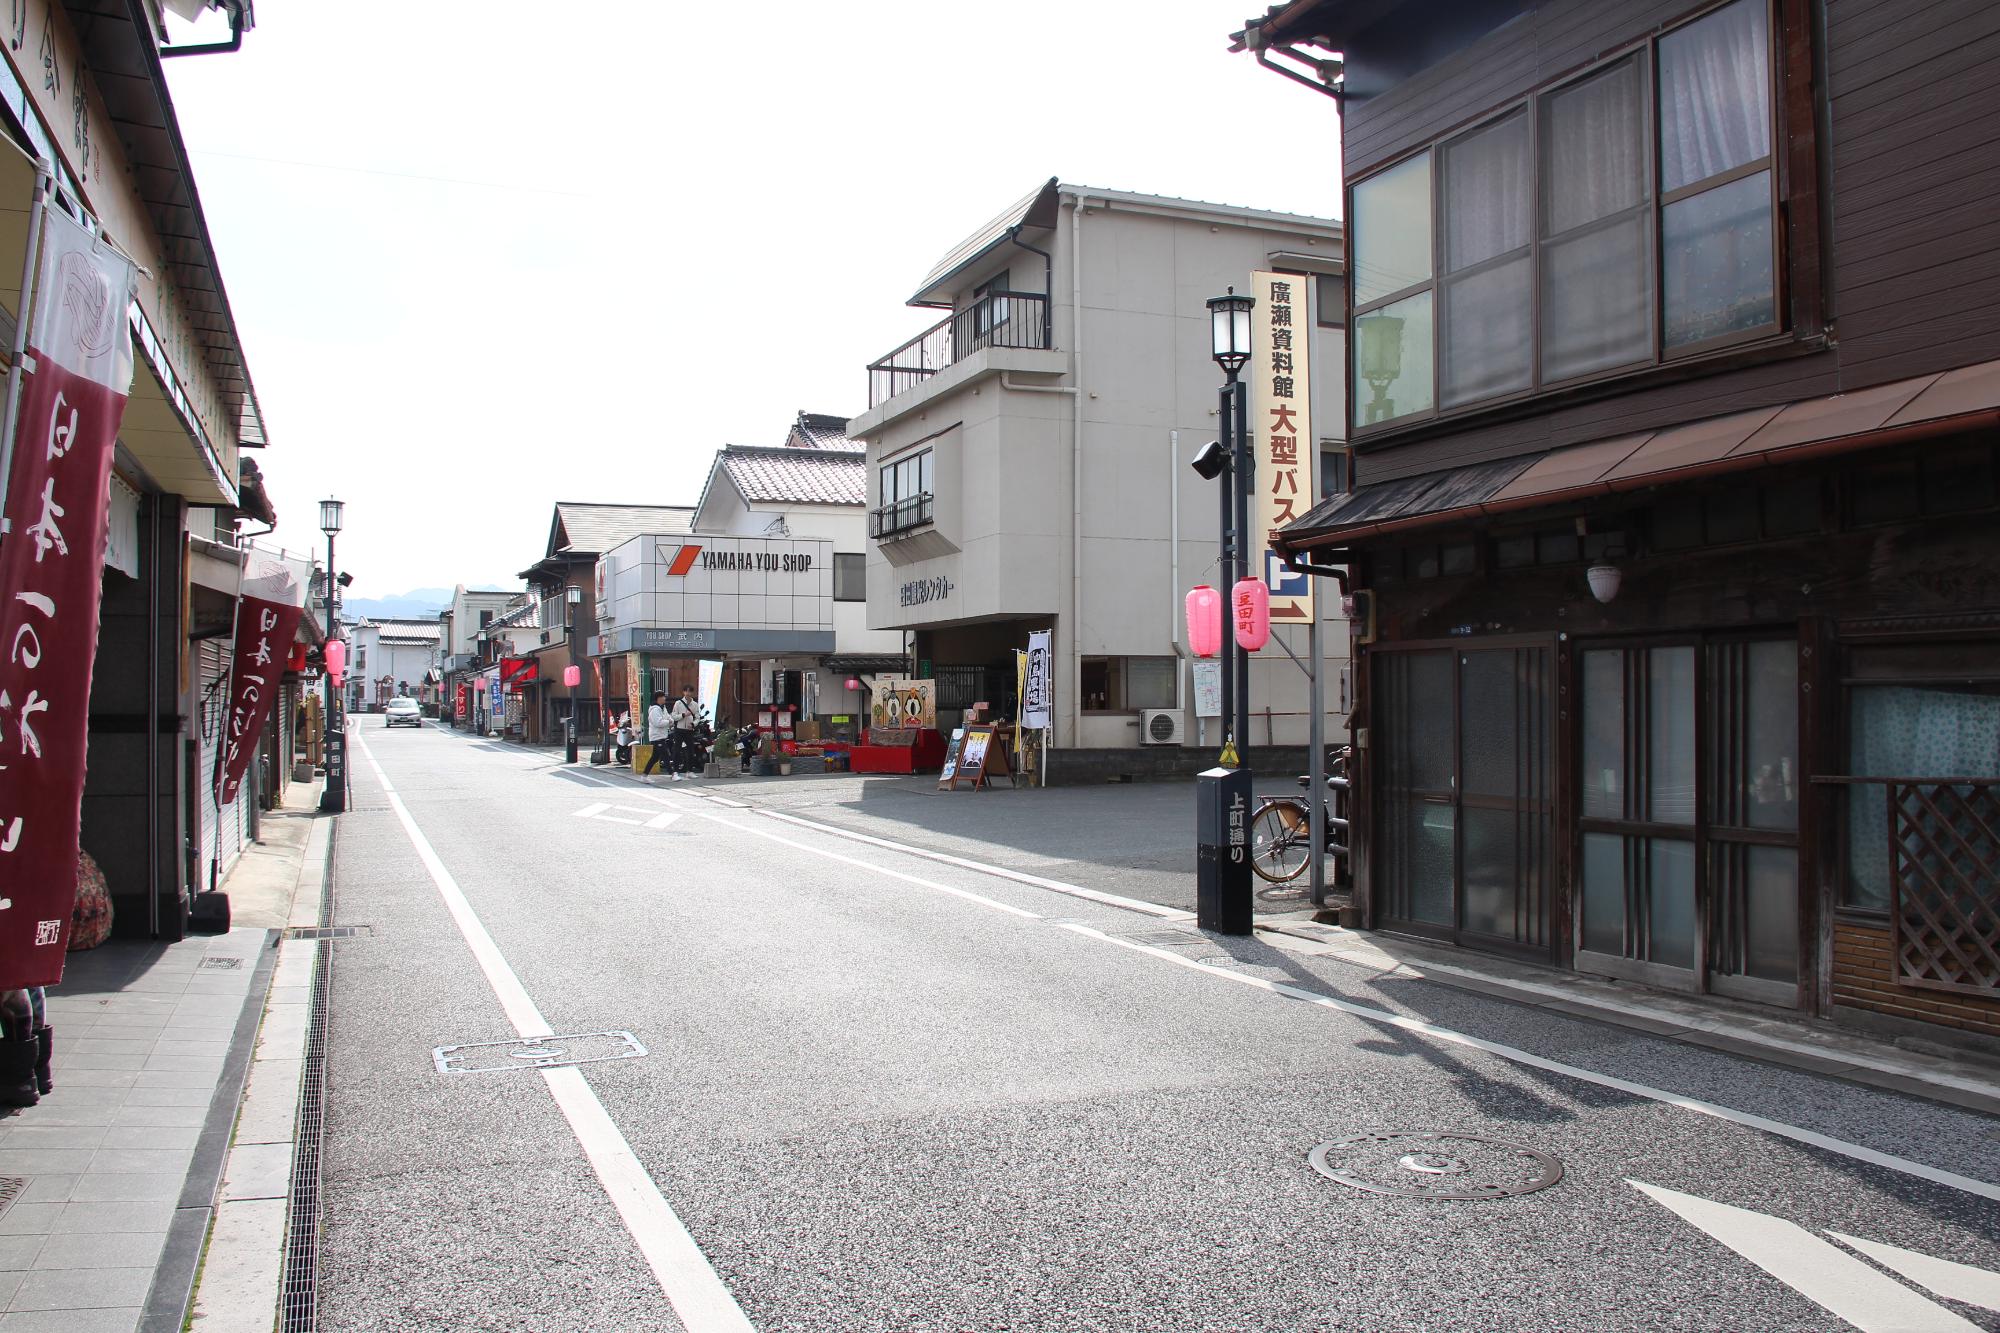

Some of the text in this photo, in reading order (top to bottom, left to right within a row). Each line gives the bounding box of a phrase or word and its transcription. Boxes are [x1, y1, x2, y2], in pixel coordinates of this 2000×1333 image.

[1270, 282, 1294, 398] 廣瀬資料館
[703, 552, 812, 572] YAMAHA YOU SHOP
[1270, 556, 1303, 590] P
[1238, 592, 1255, 634] 豆田町
[1230, 792, 1244, 863] 上町通り
